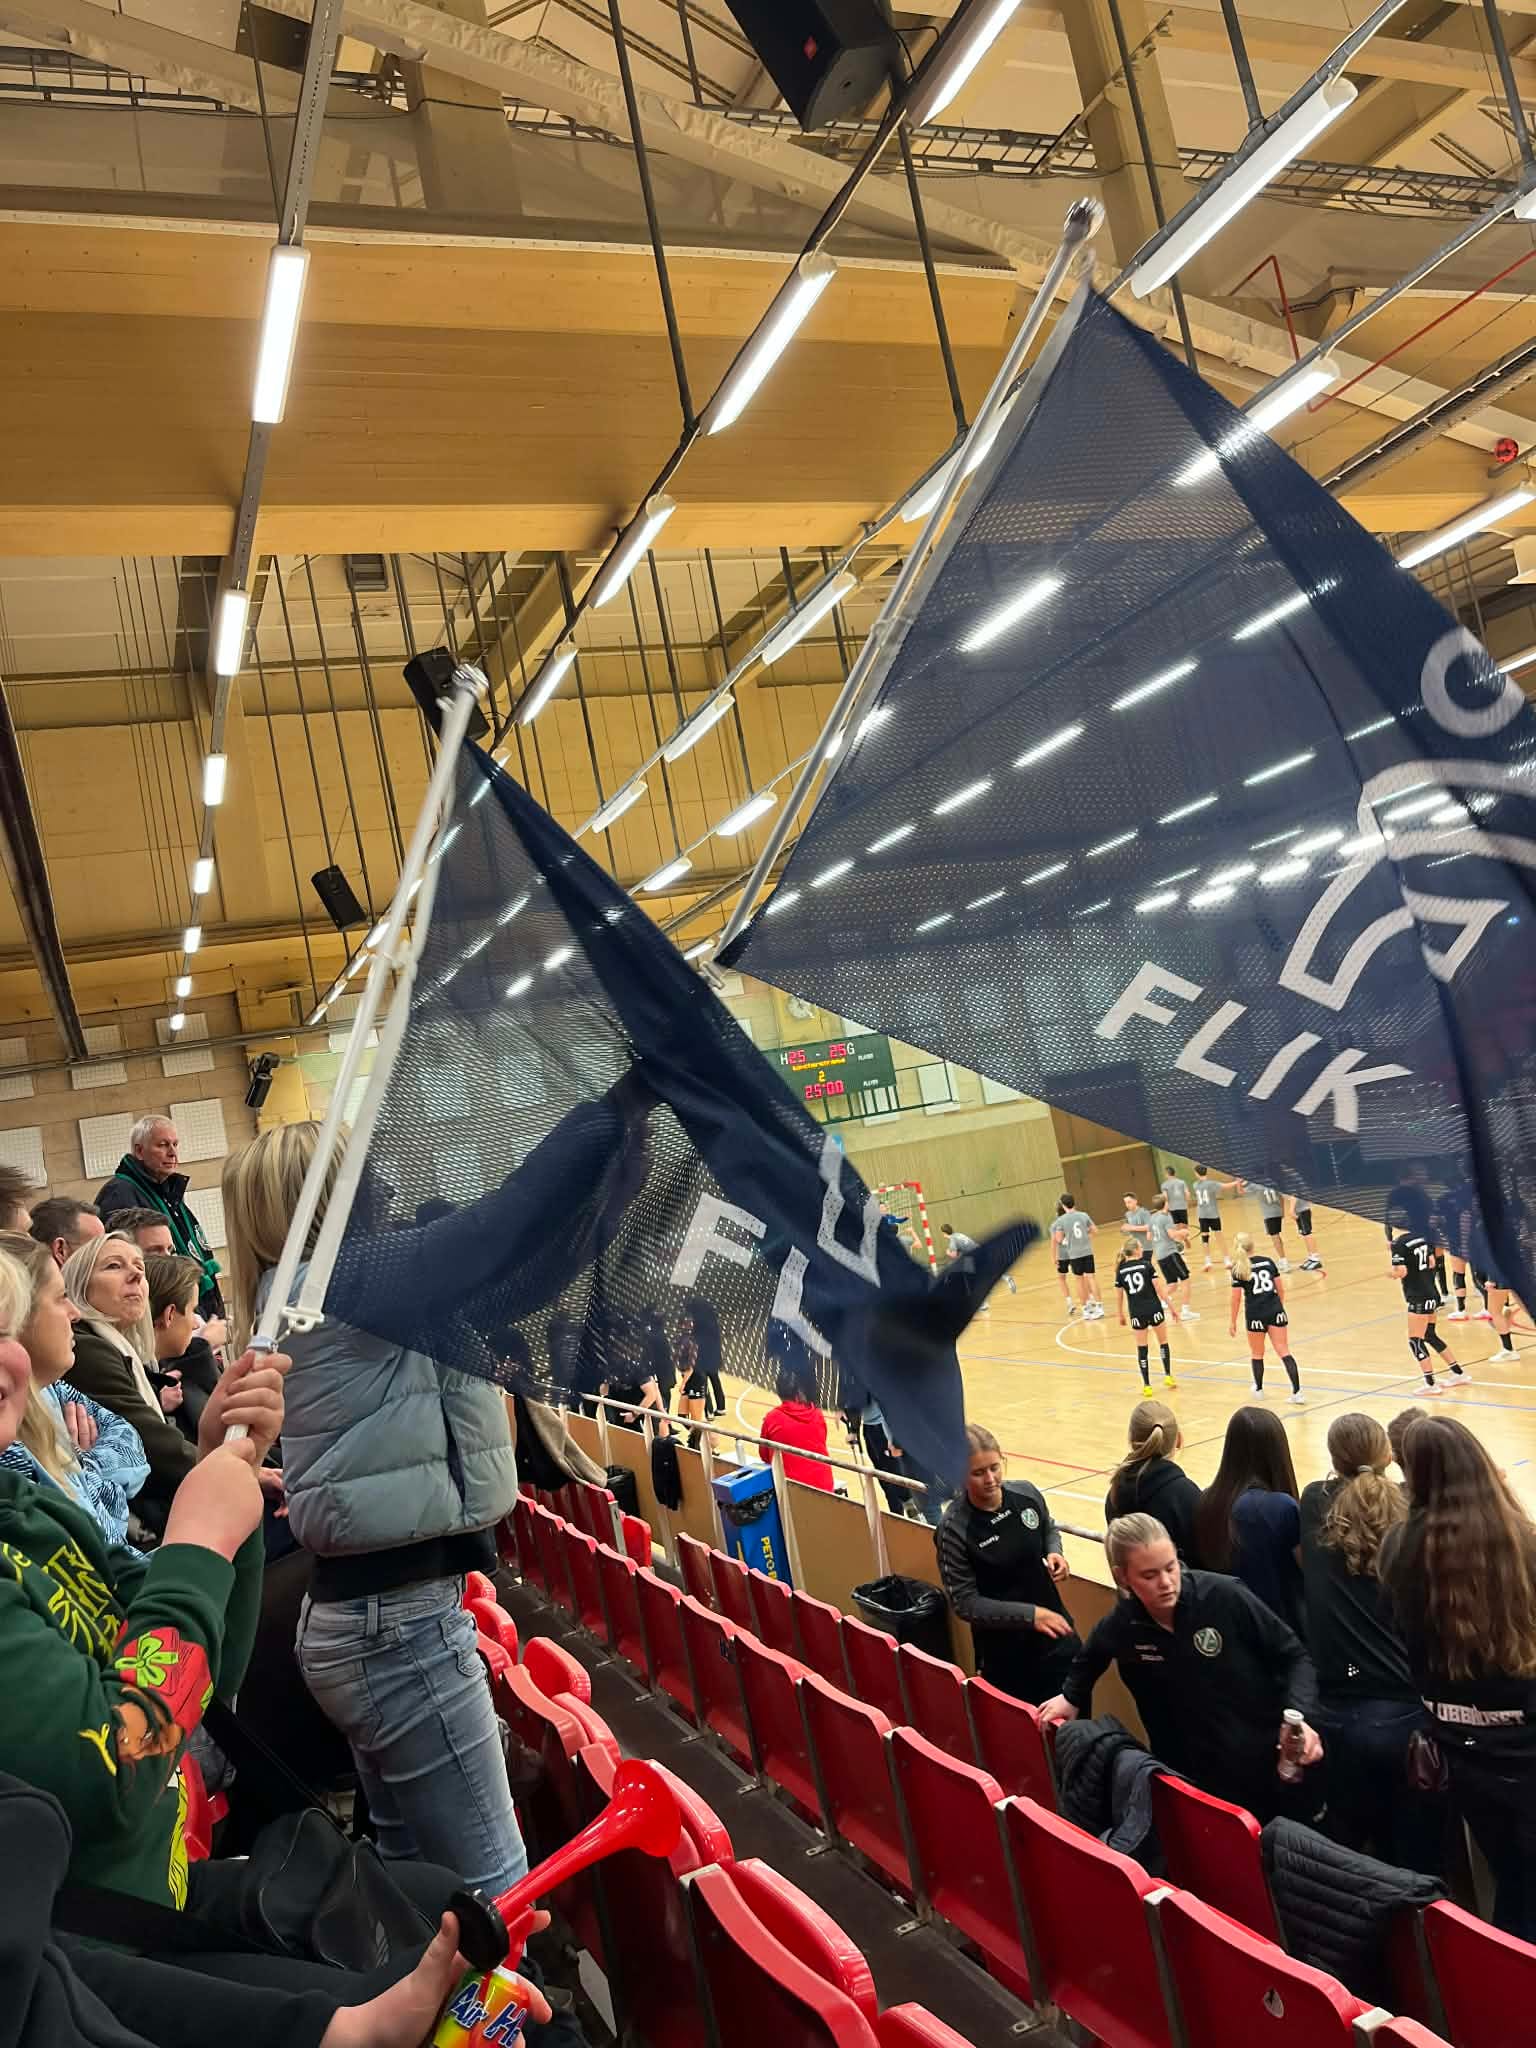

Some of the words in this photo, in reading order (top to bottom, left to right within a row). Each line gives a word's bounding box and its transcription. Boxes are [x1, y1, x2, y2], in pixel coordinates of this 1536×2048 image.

[788, 1049, 806, 1065] 25
[829, 1043, 847, 1058] 25
[1094, 961, 1414, 1133] FLIK
[818, 1070, 826, 1082] 2
[1196, 1189, 1210, 1205] 14
[1073, 1221, 1082, 1239] 6
[1414, 1245, 1428, 1270] 27
[1124, 1272, 1144, 1294] 19
[1250, 1270, 1273, 1294] 28
[450, 1981, 489, 2028] Air
